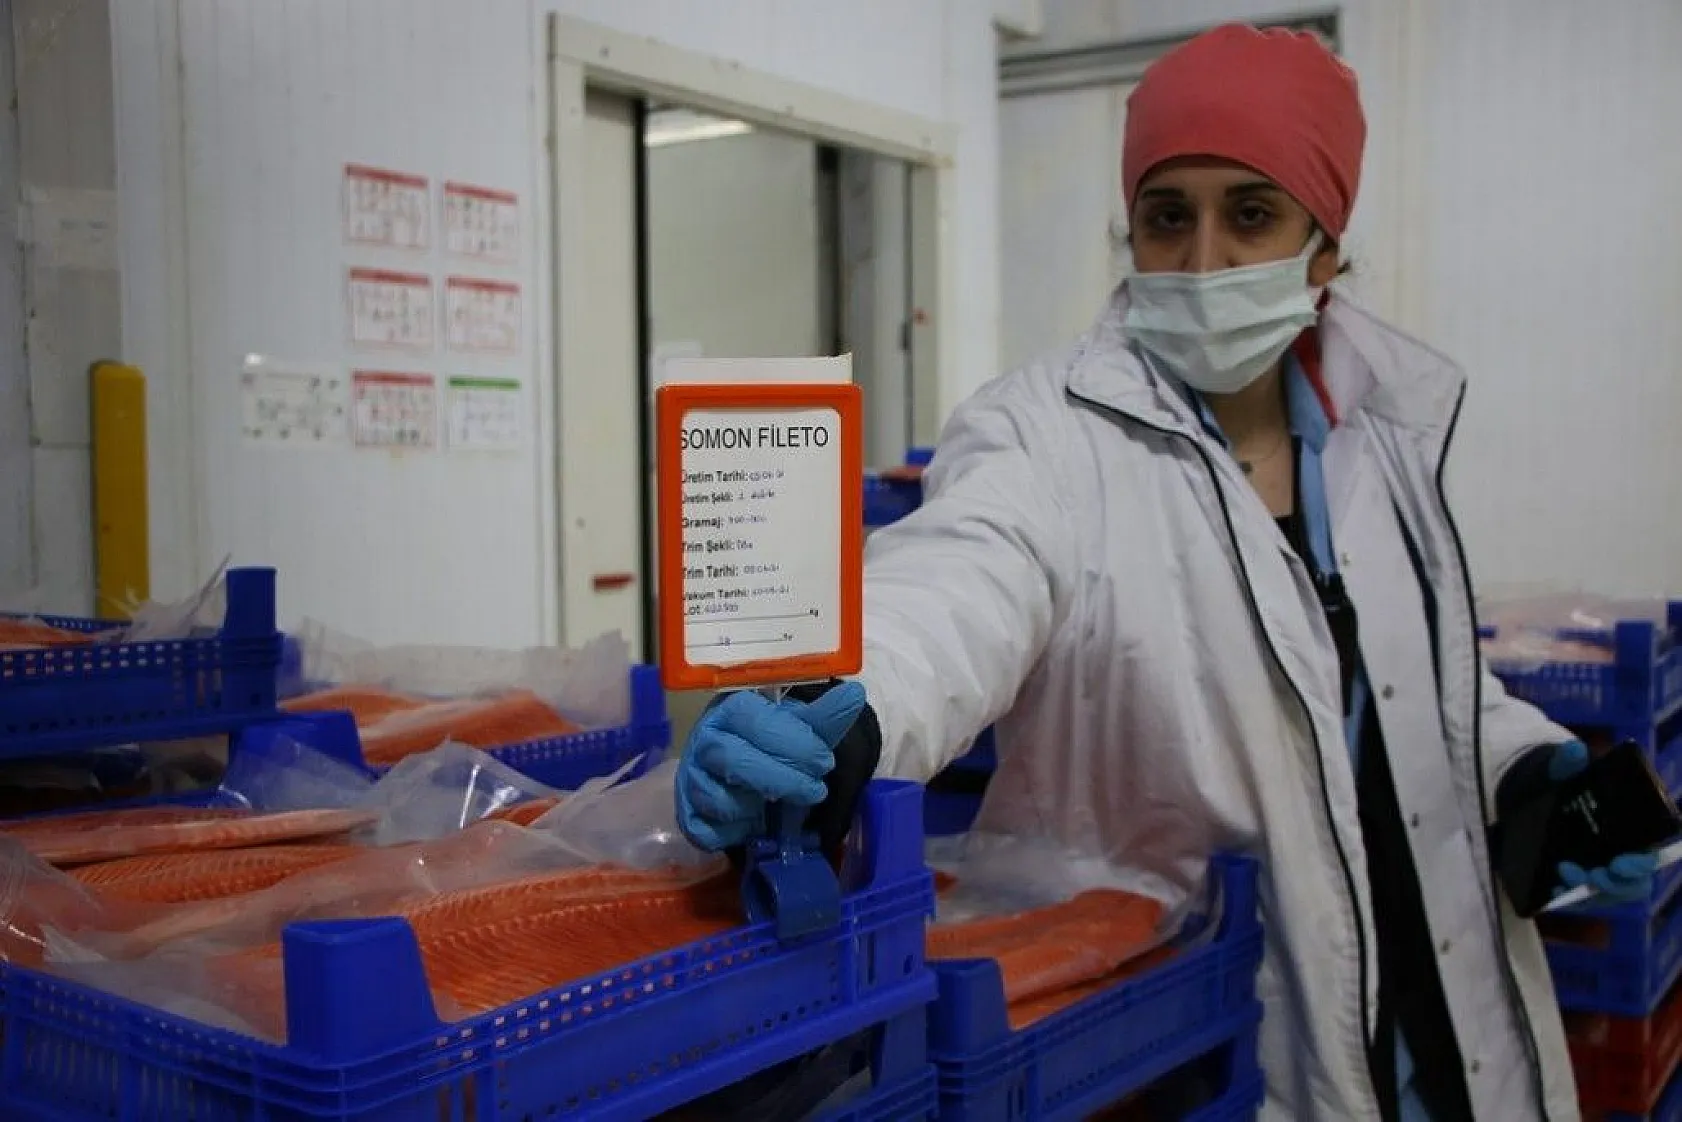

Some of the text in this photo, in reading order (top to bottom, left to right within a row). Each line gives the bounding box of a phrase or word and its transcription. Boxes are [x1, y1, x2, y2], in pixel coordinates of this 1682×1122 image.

[681, 424, 829, 449] SOMON FİLETO
[716, 470, 748, 482] Tarihi:
[707, 539, 735, 553] Şekli:
[707, 564, 739, 578] Tarihi:
[718, 587, 749, 599] Tarihi:
